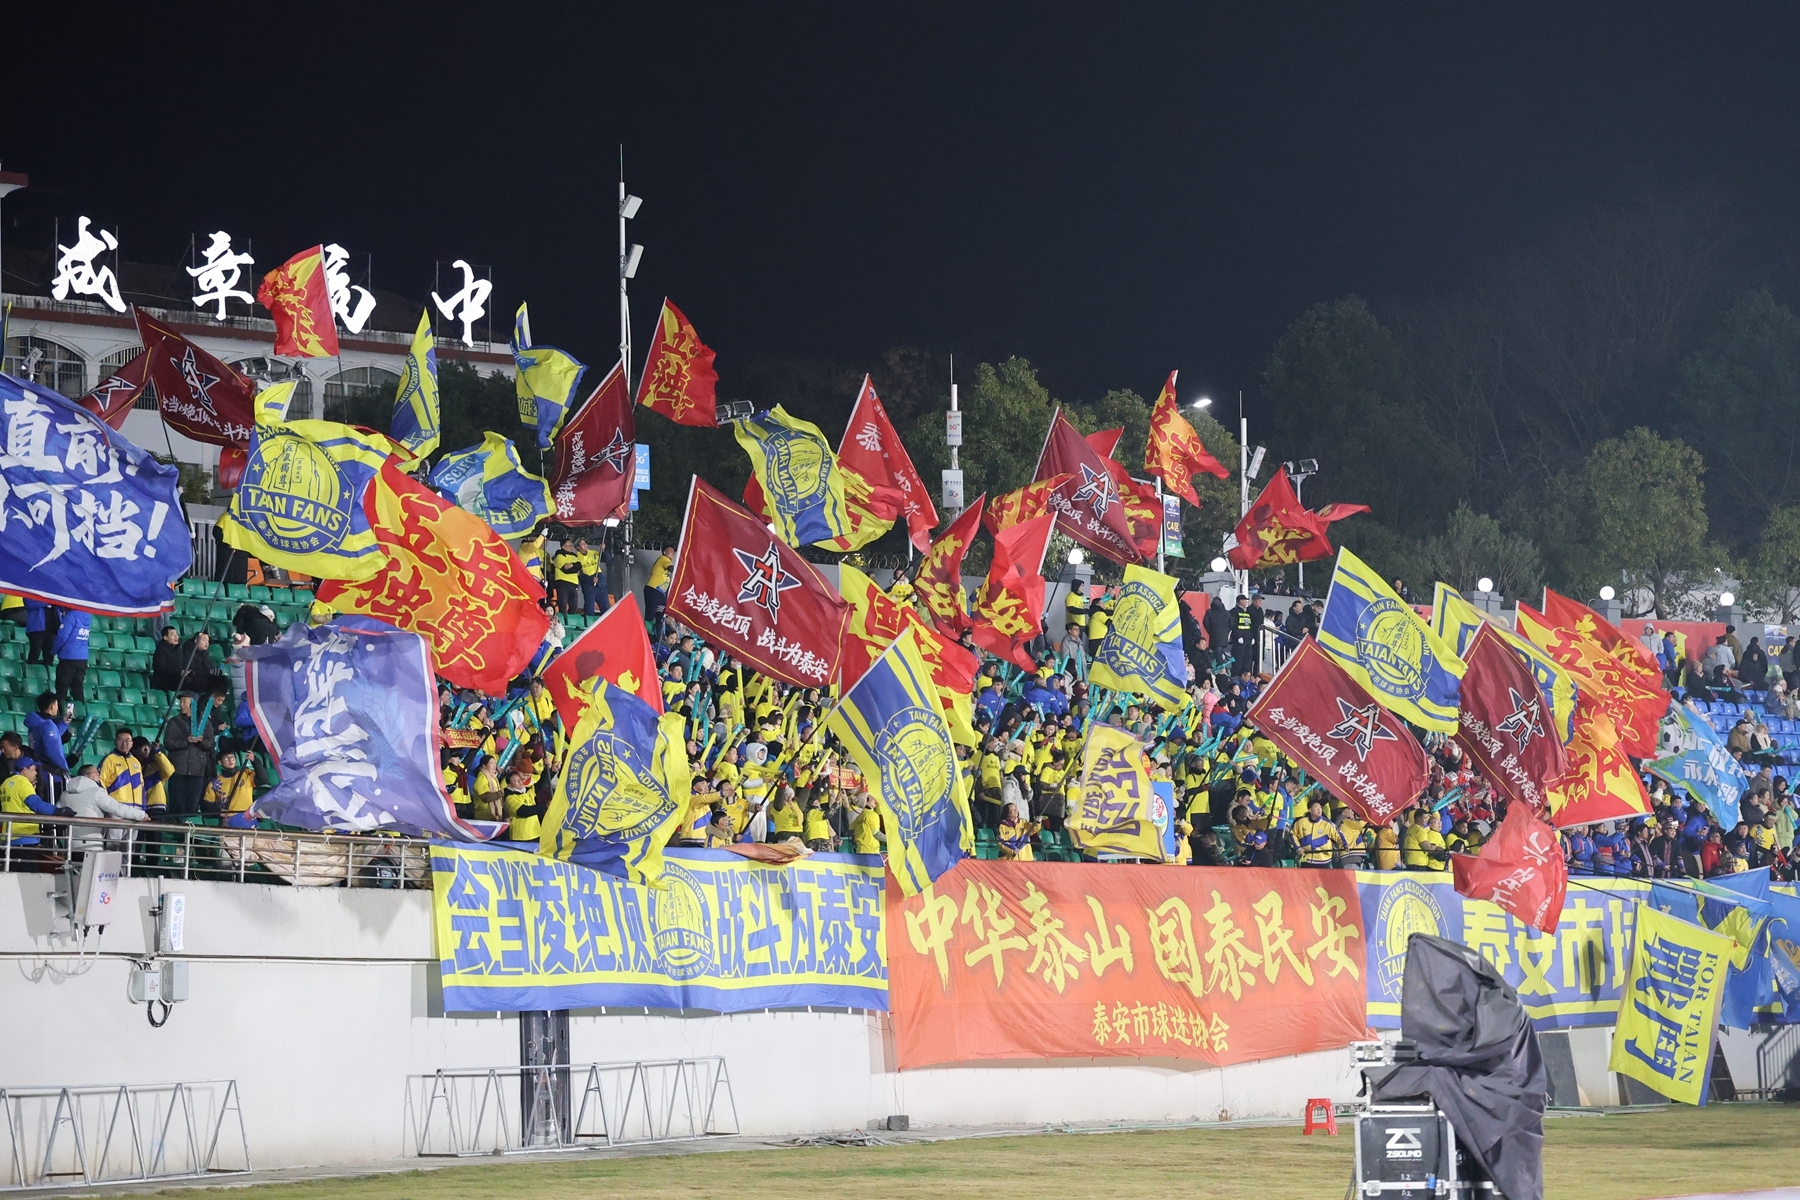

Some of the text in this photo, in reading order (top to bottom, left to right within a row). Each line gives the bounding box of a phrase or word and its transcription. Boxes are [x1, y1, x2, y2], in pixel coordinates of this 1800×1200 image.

[440, 455, 480, 488] TSCJFC
[291, 499, 343, 532] FANS
[681, 583, 830, 683] 会当凌绝顶 战斗为泰安
[1121, 641, 1158, 673] FANS
[1360, 640, 1422, 692] TAIAN FANS
[1268, 706, 1394, 817] 会当凌绝顶 战斗为泰安
[1500, 752, 1544, 808] 战斗为泰安
[99, 891, 111, 905] 5G
[666, 863, 706, 904] ASSOCIATION
[1380, 881, 1442, 922] TAIAN FANS ASSOCIATION
[447, 854, 882, 979] 会当凌绝顶 战斗为泰安
[683, 931, 711, 955] FANS
[904, 877, 1361, 1000] 中华泰山 国泰民安
[1384, 955, 1406, 978] TAIA
[1091, 1000, 1231, 1053] 泰安市球迷协会
[1679, 953, 1719, 1085] FOR TAIAN
[1385, 1149, 1423, 1159] ZSOUND
